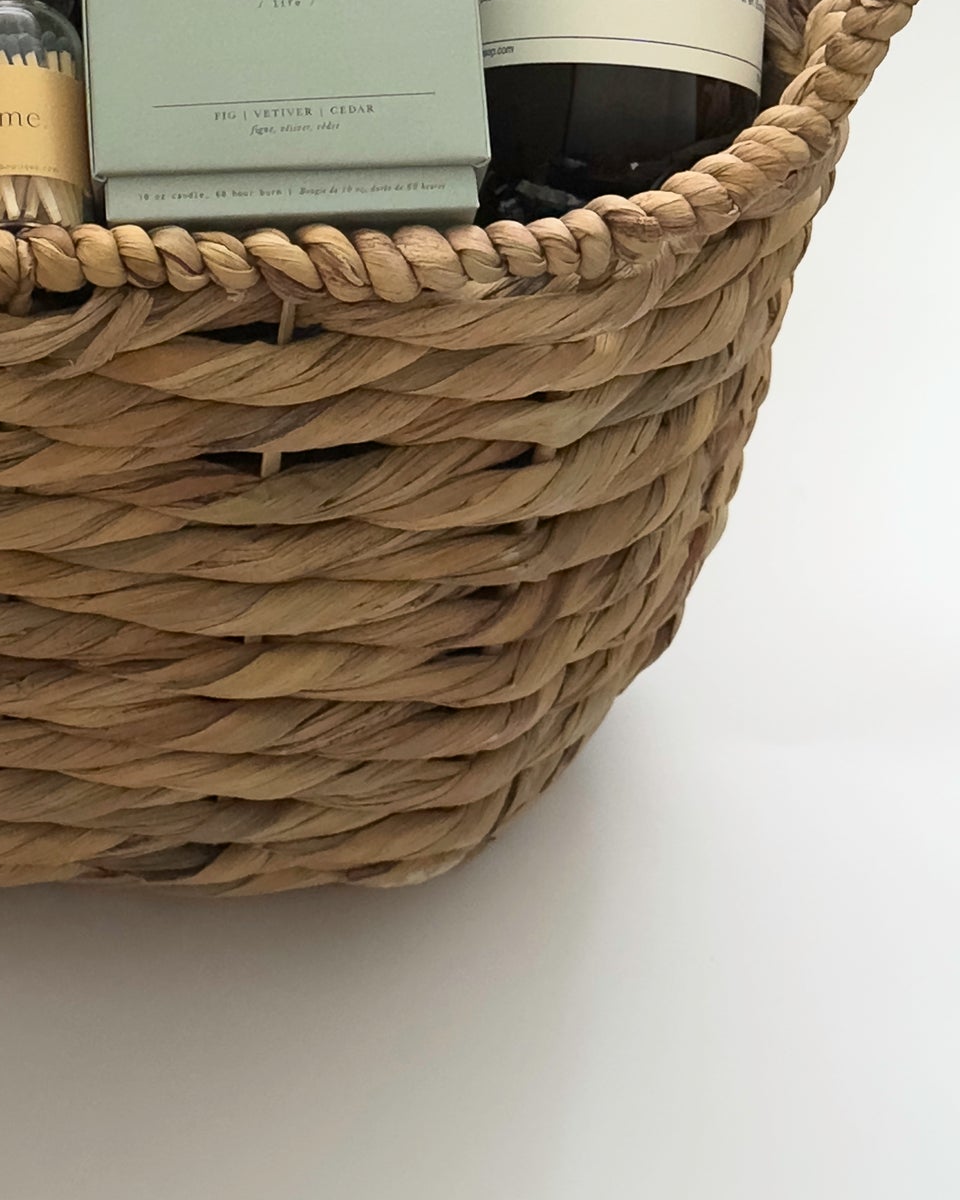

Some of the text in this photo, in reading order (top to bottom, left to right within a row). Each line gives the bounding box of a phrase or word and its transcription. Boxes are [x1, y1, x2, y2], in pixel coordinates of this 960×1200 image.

[273, 0, 301, 8] life
[214, 110, 237, 121] FIG
[253, 107, 312, 118] VETIVER
[329, 104, 375, 115] CEDAR
